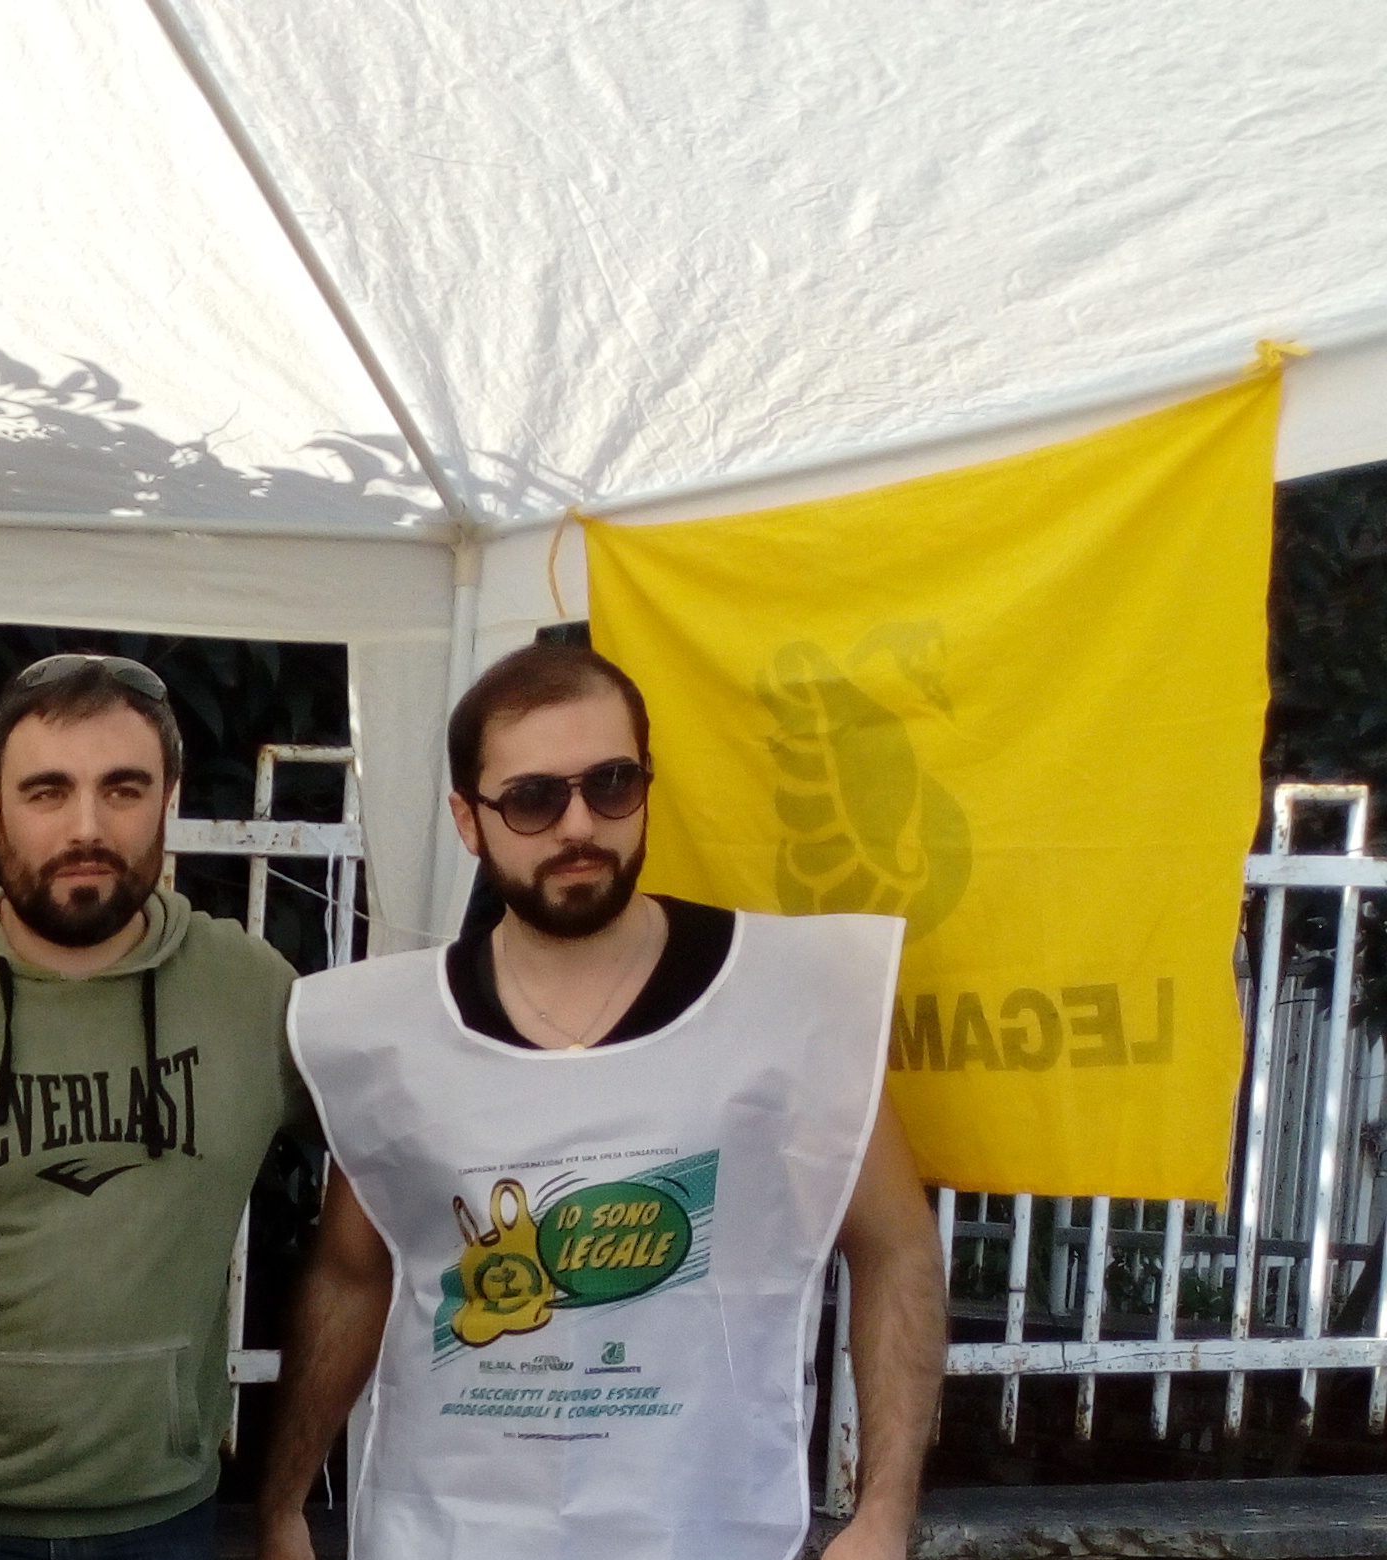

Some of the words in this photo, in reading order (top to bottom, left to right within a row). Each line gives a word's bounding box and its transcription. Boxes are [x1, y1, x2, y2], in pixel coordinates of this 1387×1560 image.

[556, 1205, 583, 1232] IO
[592, 1201, 662, 1230] SONO
[556, 1231, 677, 1273] LEGALE
[605, 1386, 662, 1400] ESSERE
